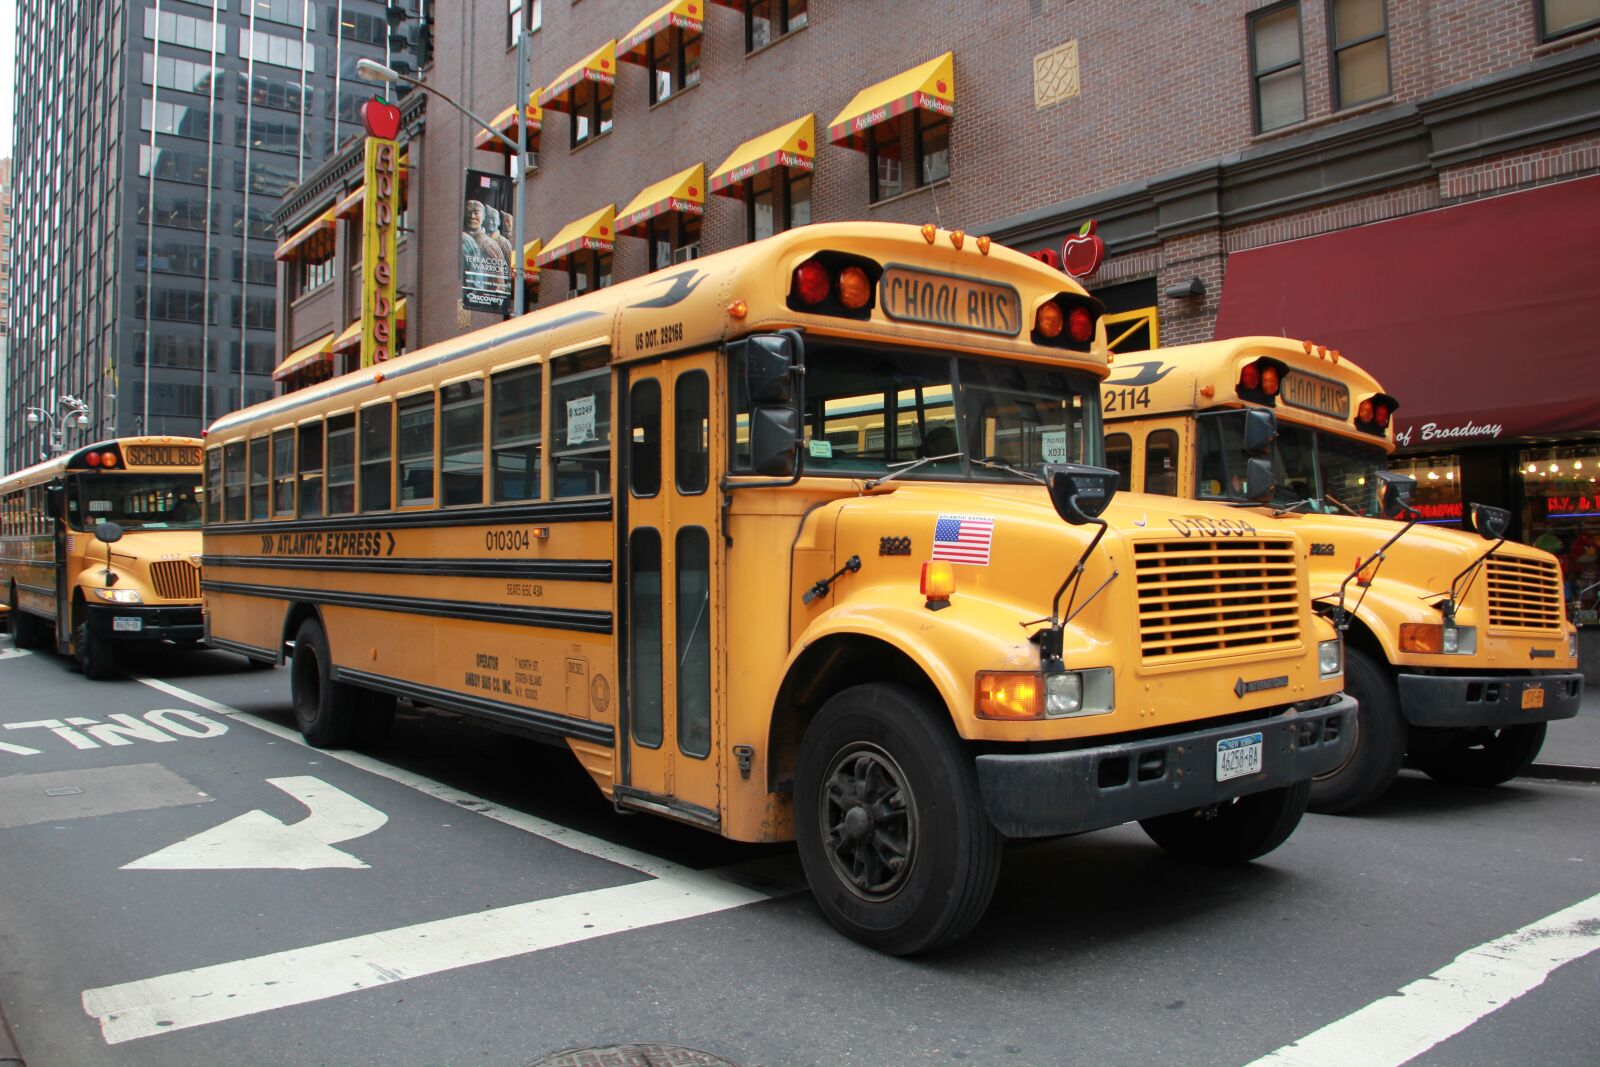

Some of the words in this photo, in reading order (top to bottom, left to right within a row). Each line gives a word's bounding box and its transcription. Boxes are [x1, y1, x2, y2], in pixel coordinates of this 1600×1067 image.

[465, 255, 508, 267] TERRACOTTA
[472, 262, 509, 274] WARRIORS
[885, 276, 957, 322] CHOOL
[967, 288, 1009, 331] BUS
[635, 332, 643, 351] US
[660, 321, 683, 345] 292168
[1103, 386, 1150, 412] 2114
[1396, 426, 1413, 446] of
[1421, 420, 1502, 440] Broadway
[130, 446, 176, 465] SCHOOL
[178, 446, 200, 465] BUS
[1168, 518, 1257, 538] 010304
[277, 532, 322, 555] ATLANTIC
[325, 531, 382, 556] EXPRESS
[486, 530, 529, 551] 010304
[476, 653, 499, 671] OPERATOR
[568, 661, 585, 676] DIESEL
[482, 674, 491, 691] BUS
[493, 676, 502, 693] CO.
